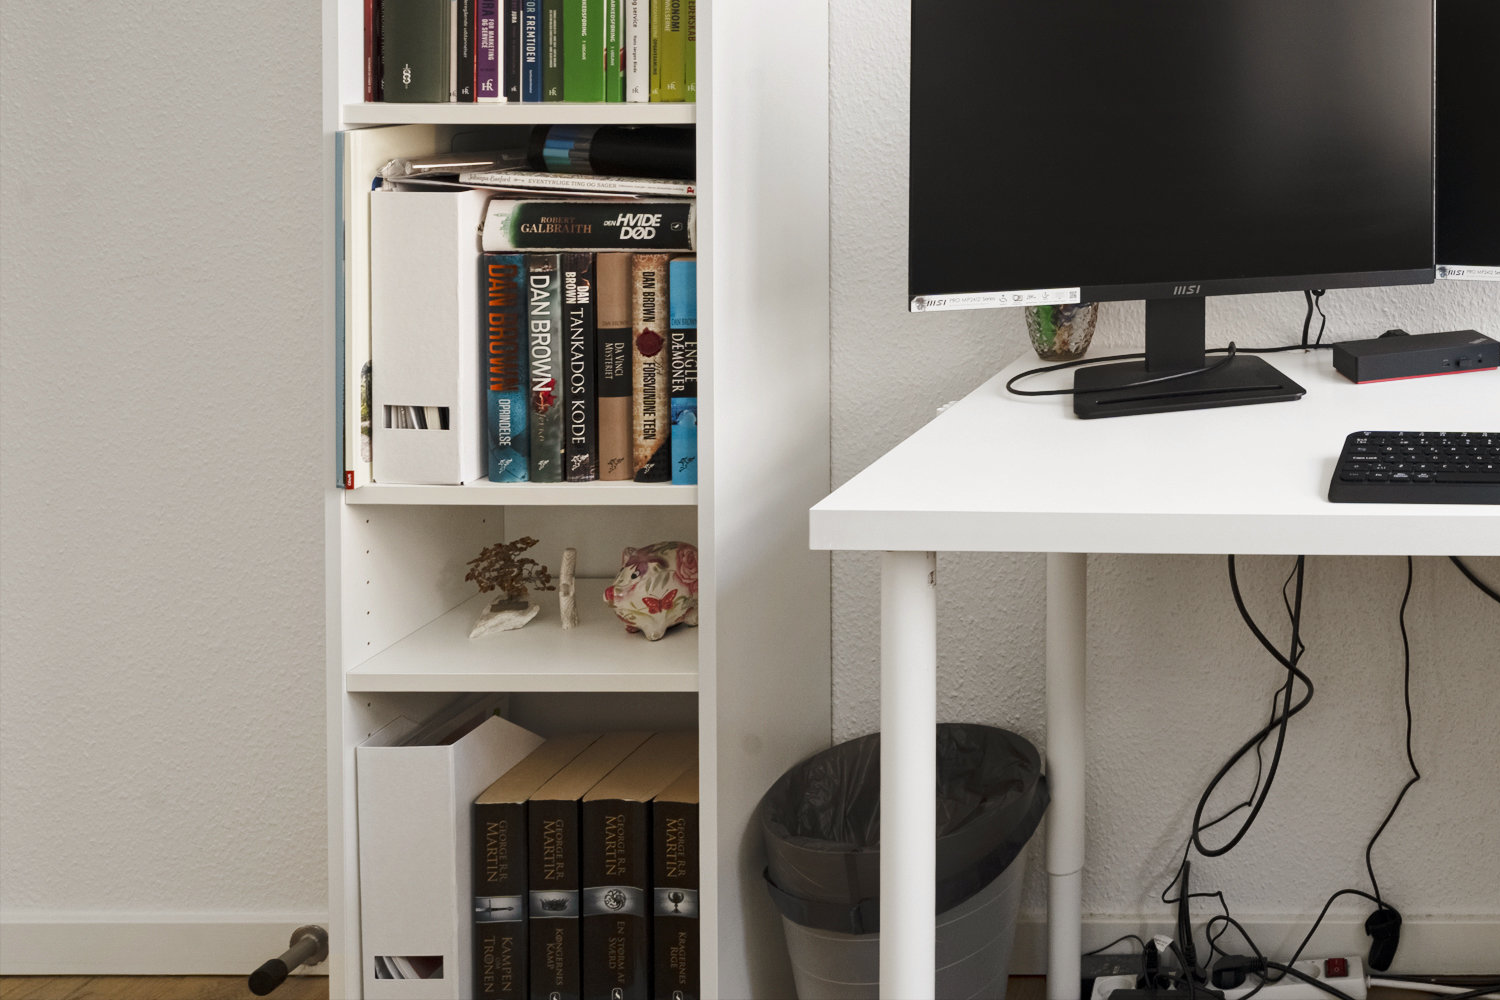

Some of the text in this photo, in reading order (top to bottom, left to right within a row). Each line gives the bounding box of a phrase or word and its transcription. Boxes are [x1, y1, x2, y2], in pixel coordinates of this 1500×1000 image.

[526, 15, 535, 63] FREMTIDEN
[520, 224, 592, 234] GALBRAITH
[541, 216, 575, 224] ROBERT
[617, 213, 662, 227] HVIDE
[620, 226, 656, 240] DØD
[565, 272, 576, 304] BROWN
[577, 286, 589, 303] DAN
[642, 271, 655, 322] DAN BROWN
[488, 264, 519, 391] DAN BROWN
[530, 275, 552, 391] DAN BROWN
[570, 308, 585, 444] TANKADOS KODE
[604, 343, 613, 379] MYSTERIET
[615, 355, 624, 376] VINCI
[672, 333, 684, 392] DÆMONER
[499, 399, 511, 446] OPRINDELSE
[643, 362, 656, 440] FORSVUNDNE TEGN
[486, 822, 498, 882] MARTIN
[543, 820, 555, 880] MARTIN
[604, 815, 616, 876] MARTIN
[665, 818, 676, 878] MARTIN
[617, 921, 624, 933] EN
[501, 937, 512, 991] KAMPEN
[546, 943, 555, 969] KAMP
[608, 937, 616, 969] SVÆRD
[670, 947, 678, 969] RIGE
[678, 932, 686, 984] KRAGERNES
[617, 972, 624, 984] AF
